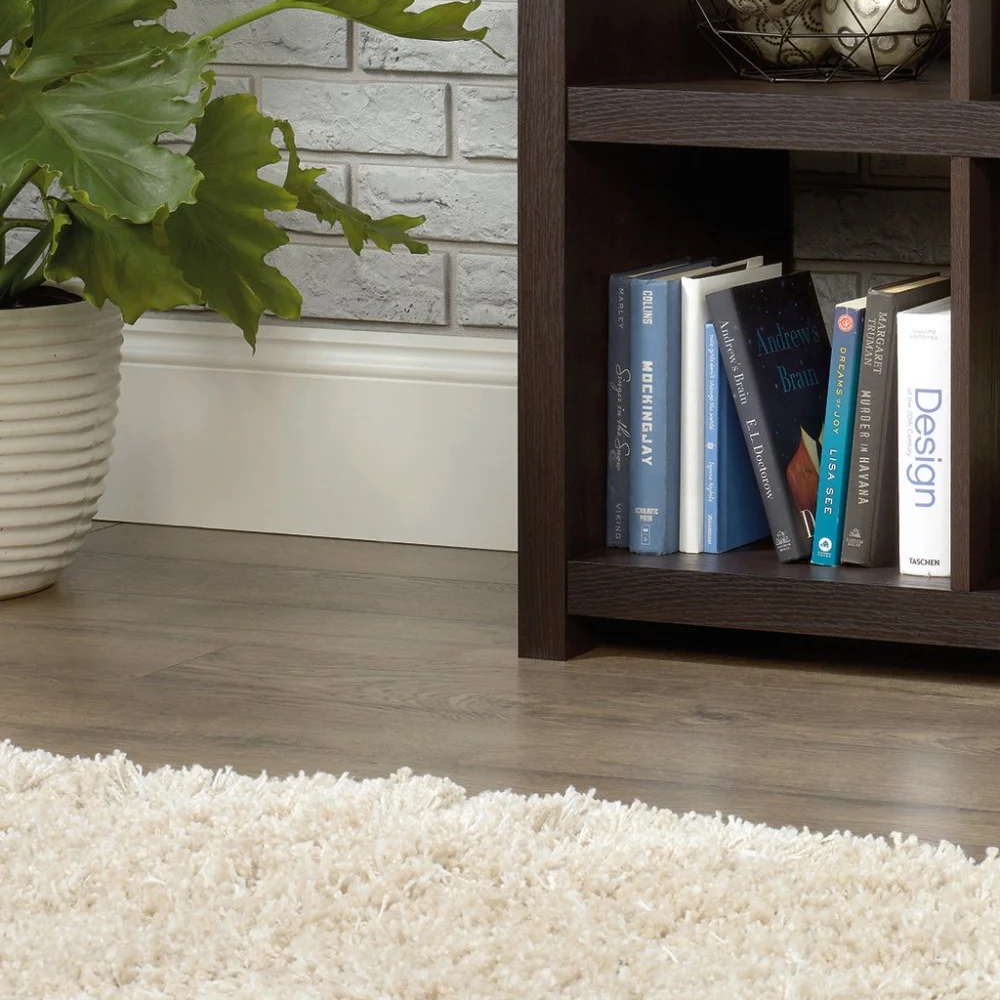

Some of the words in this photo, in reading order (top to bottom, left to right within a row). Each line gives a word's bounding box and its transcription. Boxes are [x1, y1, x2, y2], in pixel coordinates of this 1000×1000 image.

[642, 290, 652, 324] COLLINS
[756, 322, 820, 357] Andrew's
[864, 318, 876, 366] TRUMAN
[873, 312, 888, 374] MARGARET
[719, 320, 741, 372] Andrew's
[734, 374, 750, 404] Brain
[777, 360, 820, 392] Brain
[835, 347, 847, 395] DREAMS
[610, 364, 632, 402] Singer
[616, 420, 631, 437] the
[617, 405, 625, 418] in
[642, 360, 653, 466] MOCKINGJAY
[746, 418, 758, 431] E.
[832, 411, 840, 434] JOY
[860, 390, 872, 438] MURDER
[614, 438, 630, 471] Snow
[750, 431, 760, 444] L.
[906, 388, 942, 508] Design
[754, 444, 774, 500] Doctorow
[828, 448, 838, 480] LISA
[858, 457, 870, 505] HAVANA
[824, 487, 834, 514] SEE
[909, 558, 940, 566] TASCHEN
